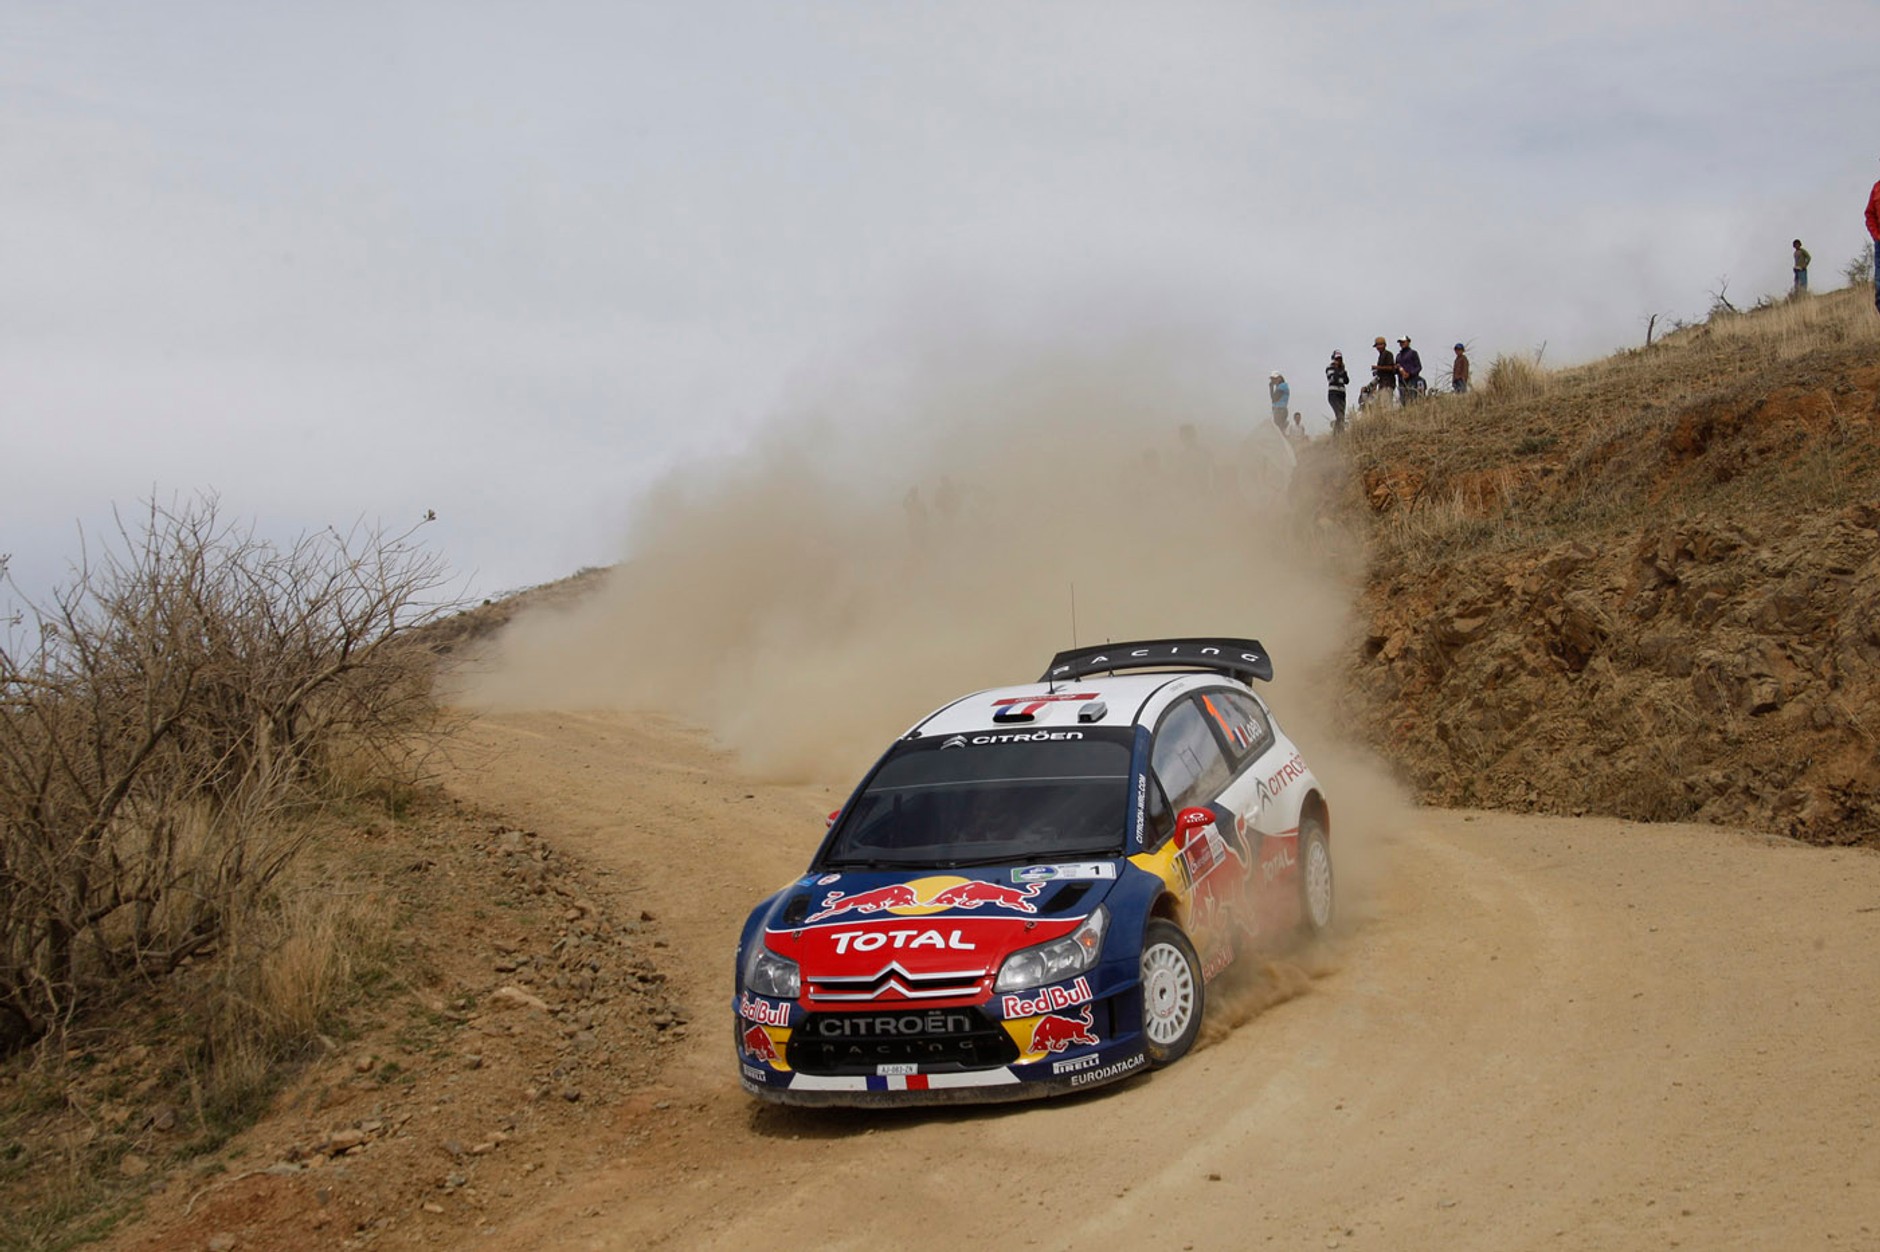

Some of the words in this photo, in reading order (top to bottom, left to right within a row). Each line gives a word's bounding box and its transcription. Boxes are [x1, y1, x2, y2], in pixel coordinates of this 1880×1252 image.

[1201, 695, 1235, 743] 1
[1089, 865, 1099, 876] 1
[831, 930, 976, 954] TOTAL
[1003, 987, 1050, 1018] Red
[1050, 977, 1092, 1009] Bull
[757, 1000, 790, 1026] Bull
[1053, 1053, 1099, 1074] PIRELLI
[1071, 1053, 1146, 1086] EURODATACAR
